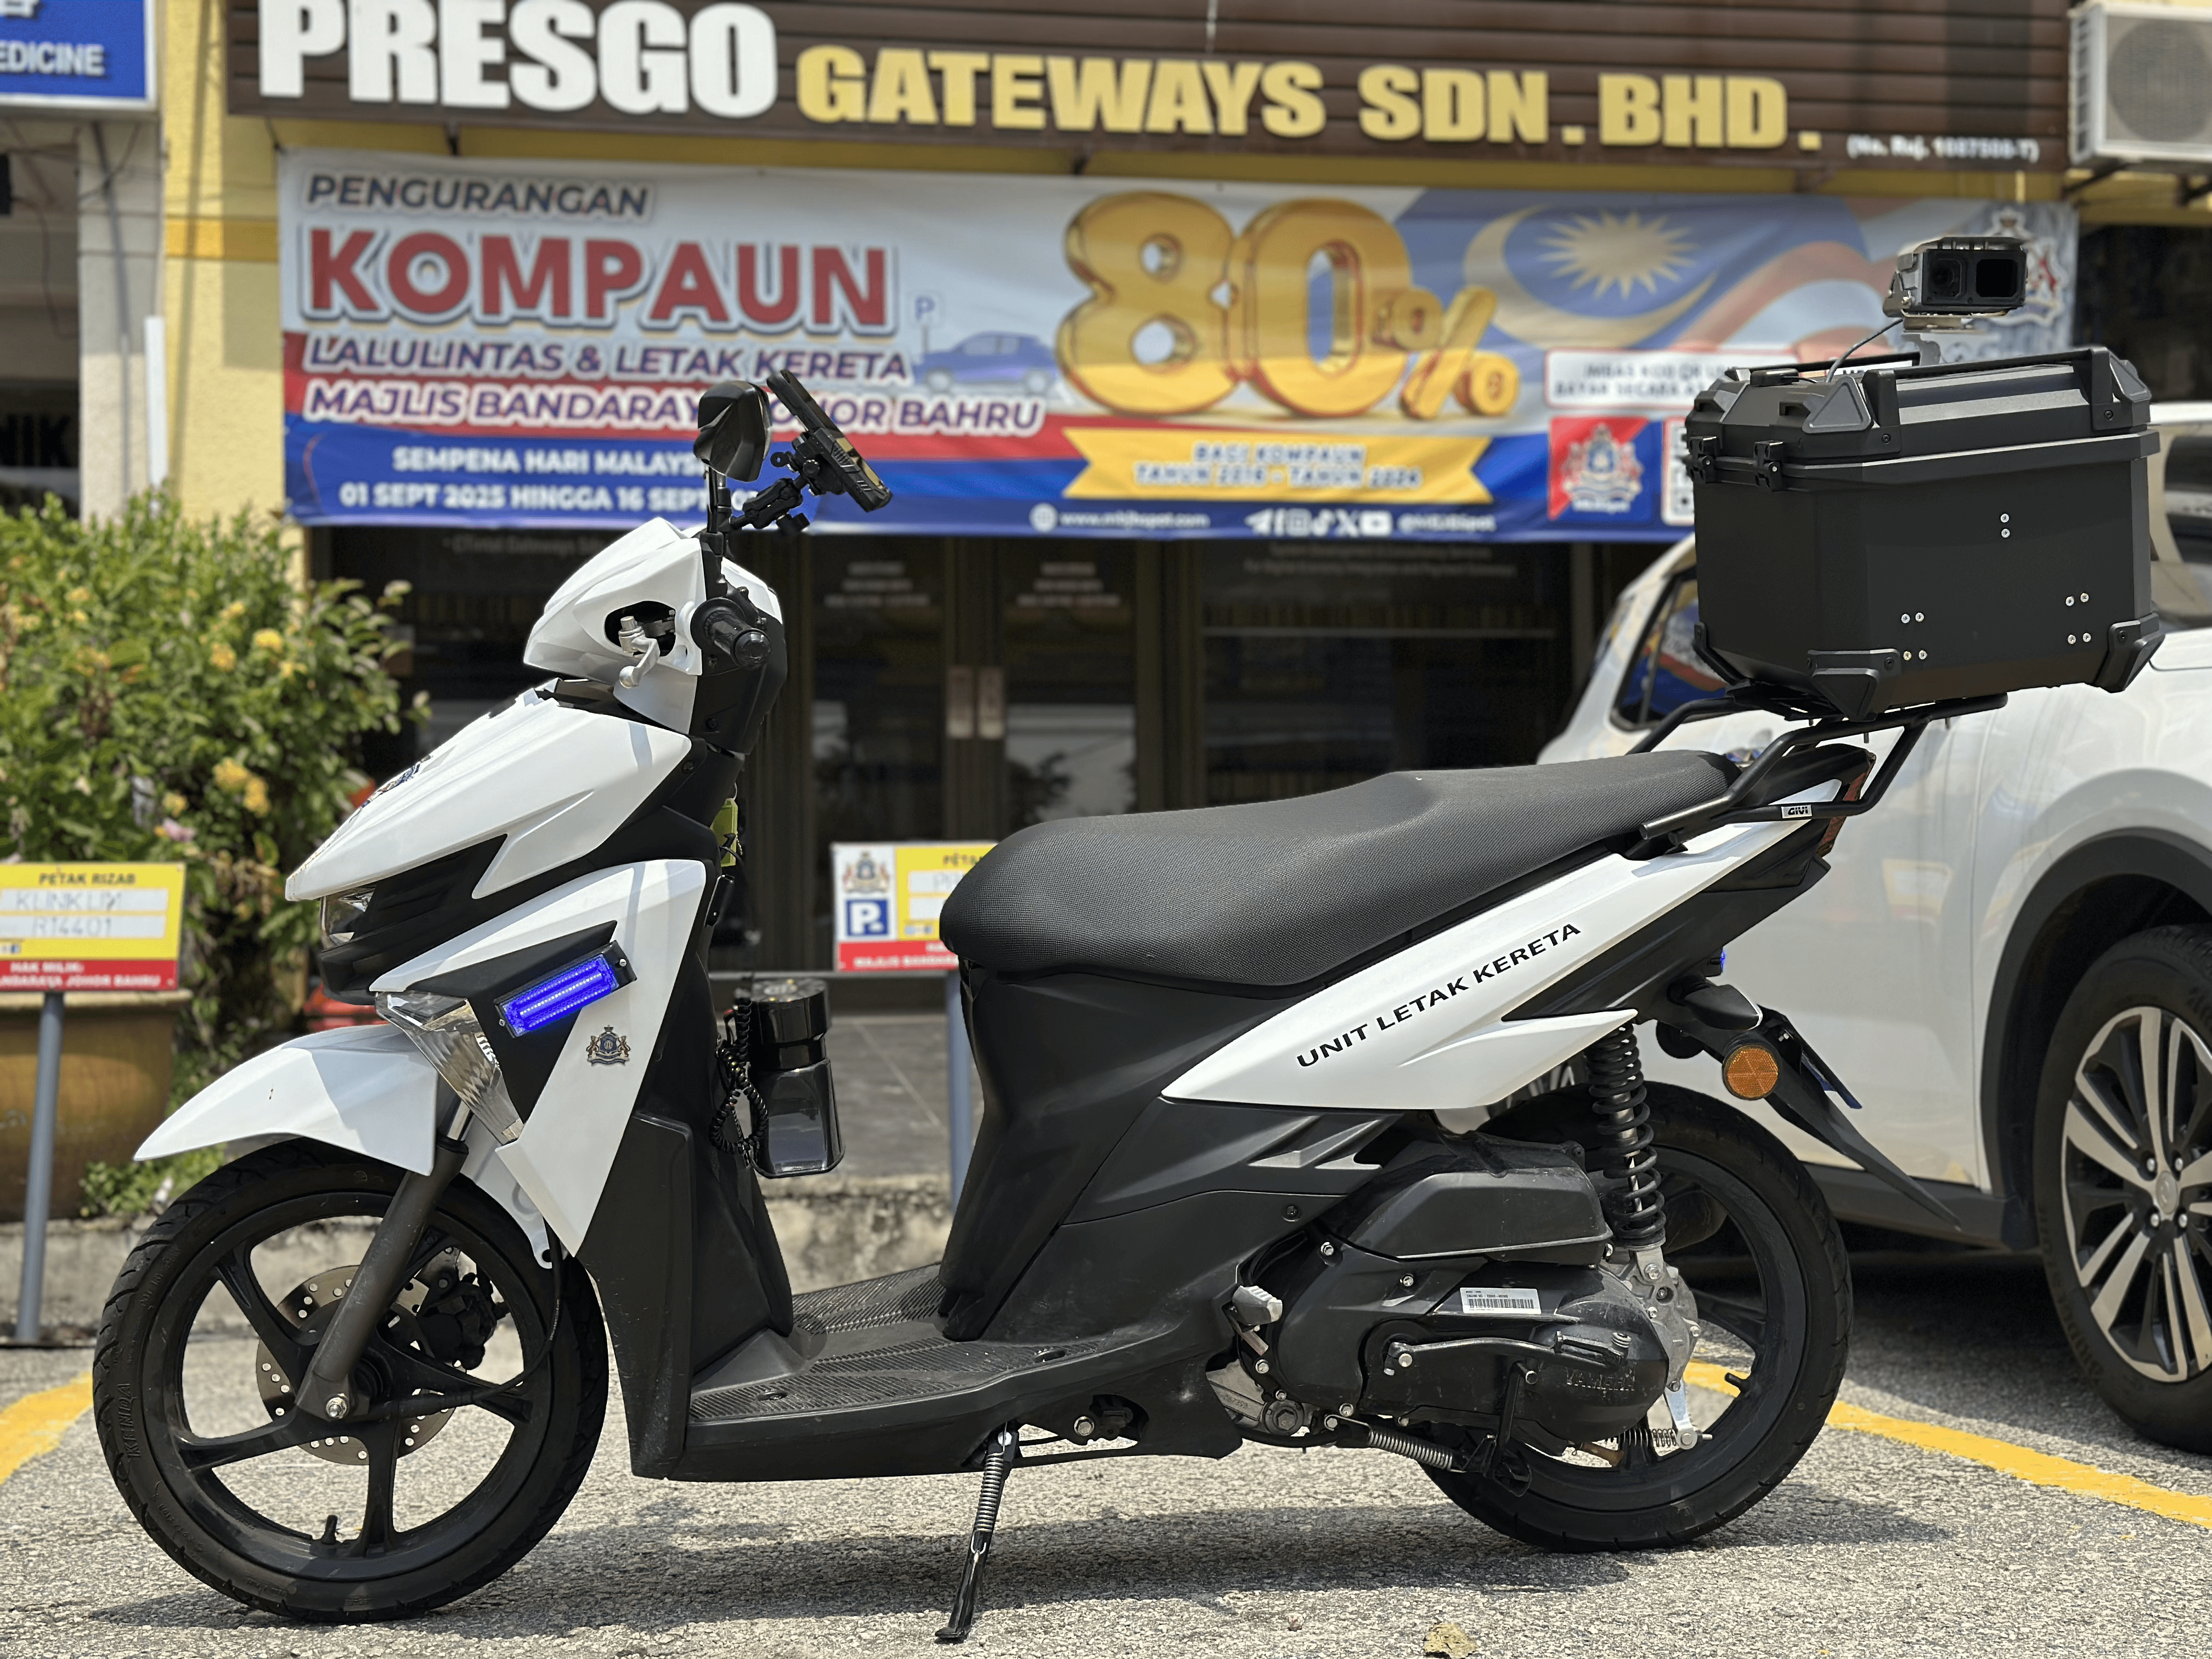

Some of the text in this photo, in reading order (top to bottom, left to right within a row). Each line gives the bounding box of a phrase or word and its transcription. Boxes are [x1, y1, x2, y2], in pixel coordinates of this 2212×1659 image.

[259, 0, 777, 119] PRESGO
[795, 45, 1325, 137] GATEWAYS
[307, 175, 649, 217] PENGURANGAN
[309, 228, 888, 326] KOMPAUN
[1054, 189, 1521, 420] 80%
[310, 339, 909, 380] LALULINTAS & LETAK KERETA
[309, 386, 462, 416] MAJLIS
[900, 399, 1039, 429] BAHRU
[392, 447, 521, 473] SEMPENA
[524, 450, 589, 474] HARI
[1254, 443, 1365, 464] KOMPAUN
[1135, 461, 1211, 486] TAHUN
[1289, 465, 1363, 488] TAHUN
[338, 483, 368, 507] 01
[373, 483, 437, 508] SEPT
[510, 487, 614, 511] HINGGA
[39, 872, 87, 886] PETAK
[1296, 923, 1582, 1068] UNIT LETAK KERETA
